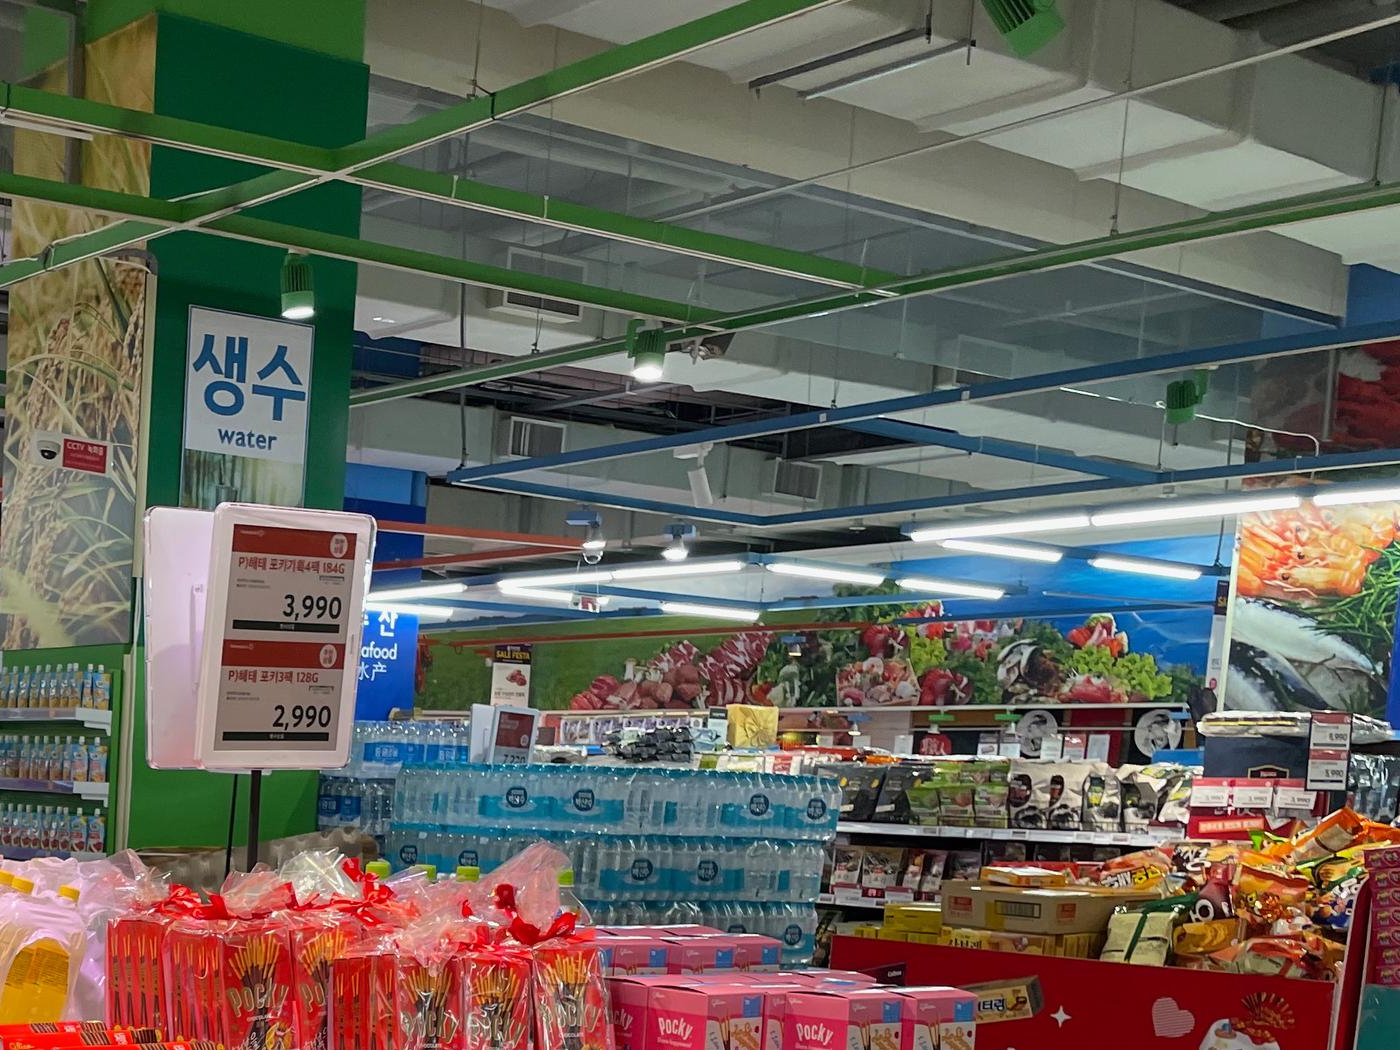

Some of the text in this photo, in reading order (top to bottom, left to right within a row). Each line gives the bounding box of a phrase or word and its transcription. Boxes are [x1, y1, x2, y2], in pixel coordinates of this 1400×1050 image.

[192, 334, 306, 421] 생수
[66, 441, 85, 451] CCTV
[217, 428, 277, 450] water
[238, 557, 345, 575] P)해태 포키기획4팩 184G
[283, 594, 342, 622] 3,990
[361, 641, 398, 659] afood
[510, 651, 531, 660] FESTA
[228, 670, 319, 684] P)해태 포키3팩 128G
[272, 704, 331, 731] 2,990
[657, 1017, 693, 1040] Pocky
[795, 1021, 834, 1046] Pocky
